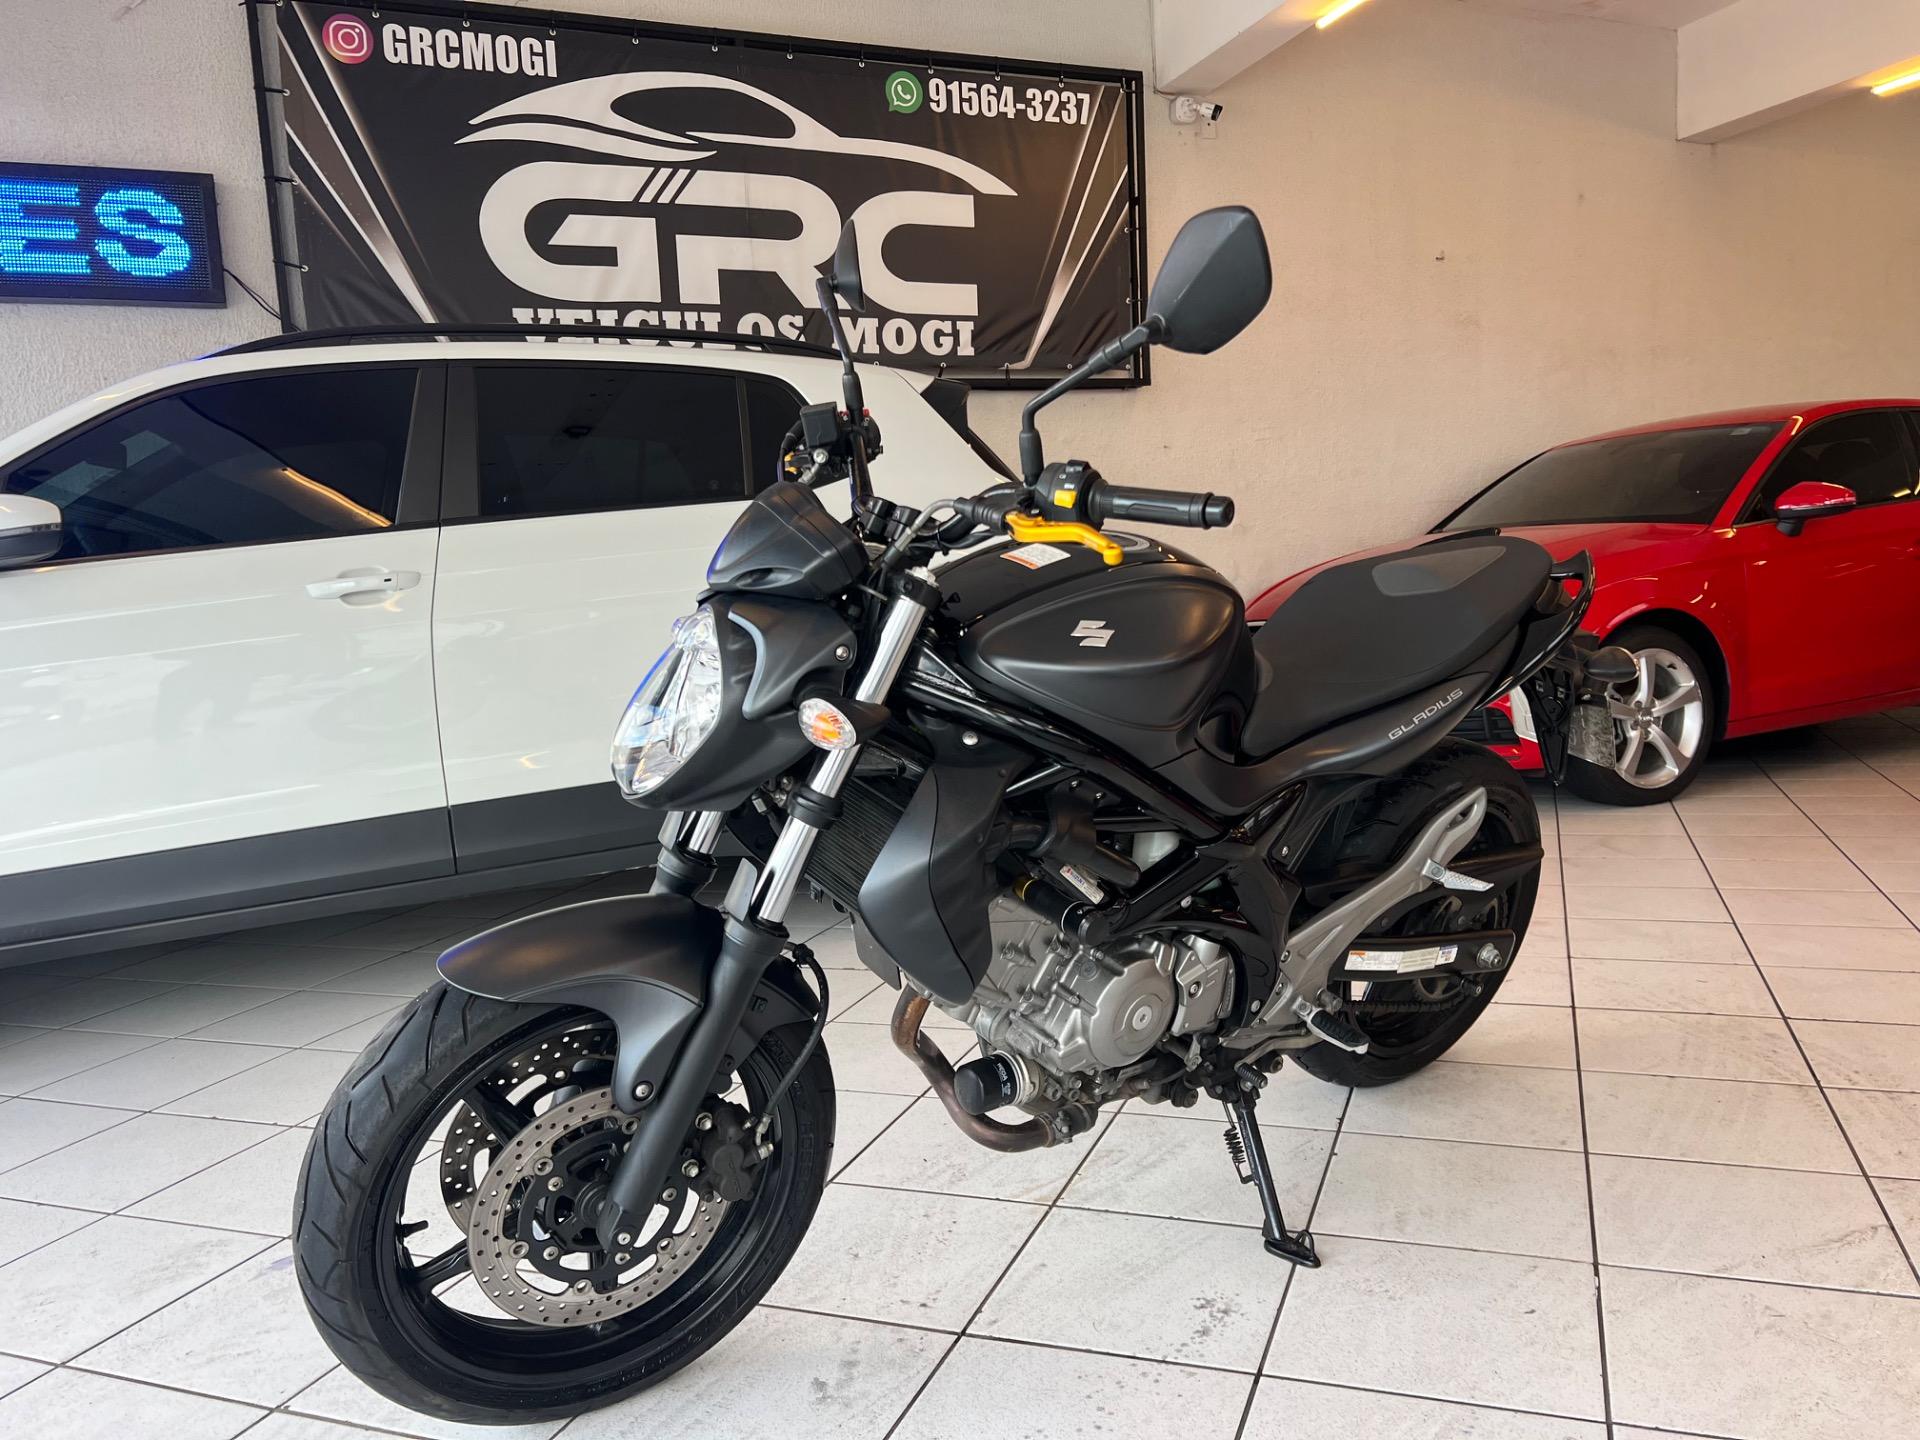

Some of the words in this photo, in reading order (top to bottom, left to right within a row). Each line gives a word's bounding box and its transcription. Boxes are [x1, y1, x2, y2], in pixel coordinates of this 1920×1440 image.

[382, 23, 558, 78] GRCMOGI
[928, 77, 1091, 125] 91564-3237
[479, 161, 979, 317] GRC
[831, 316, 975, 357] MOGI
[1388, 687, 1464, 741] GLADIUS
